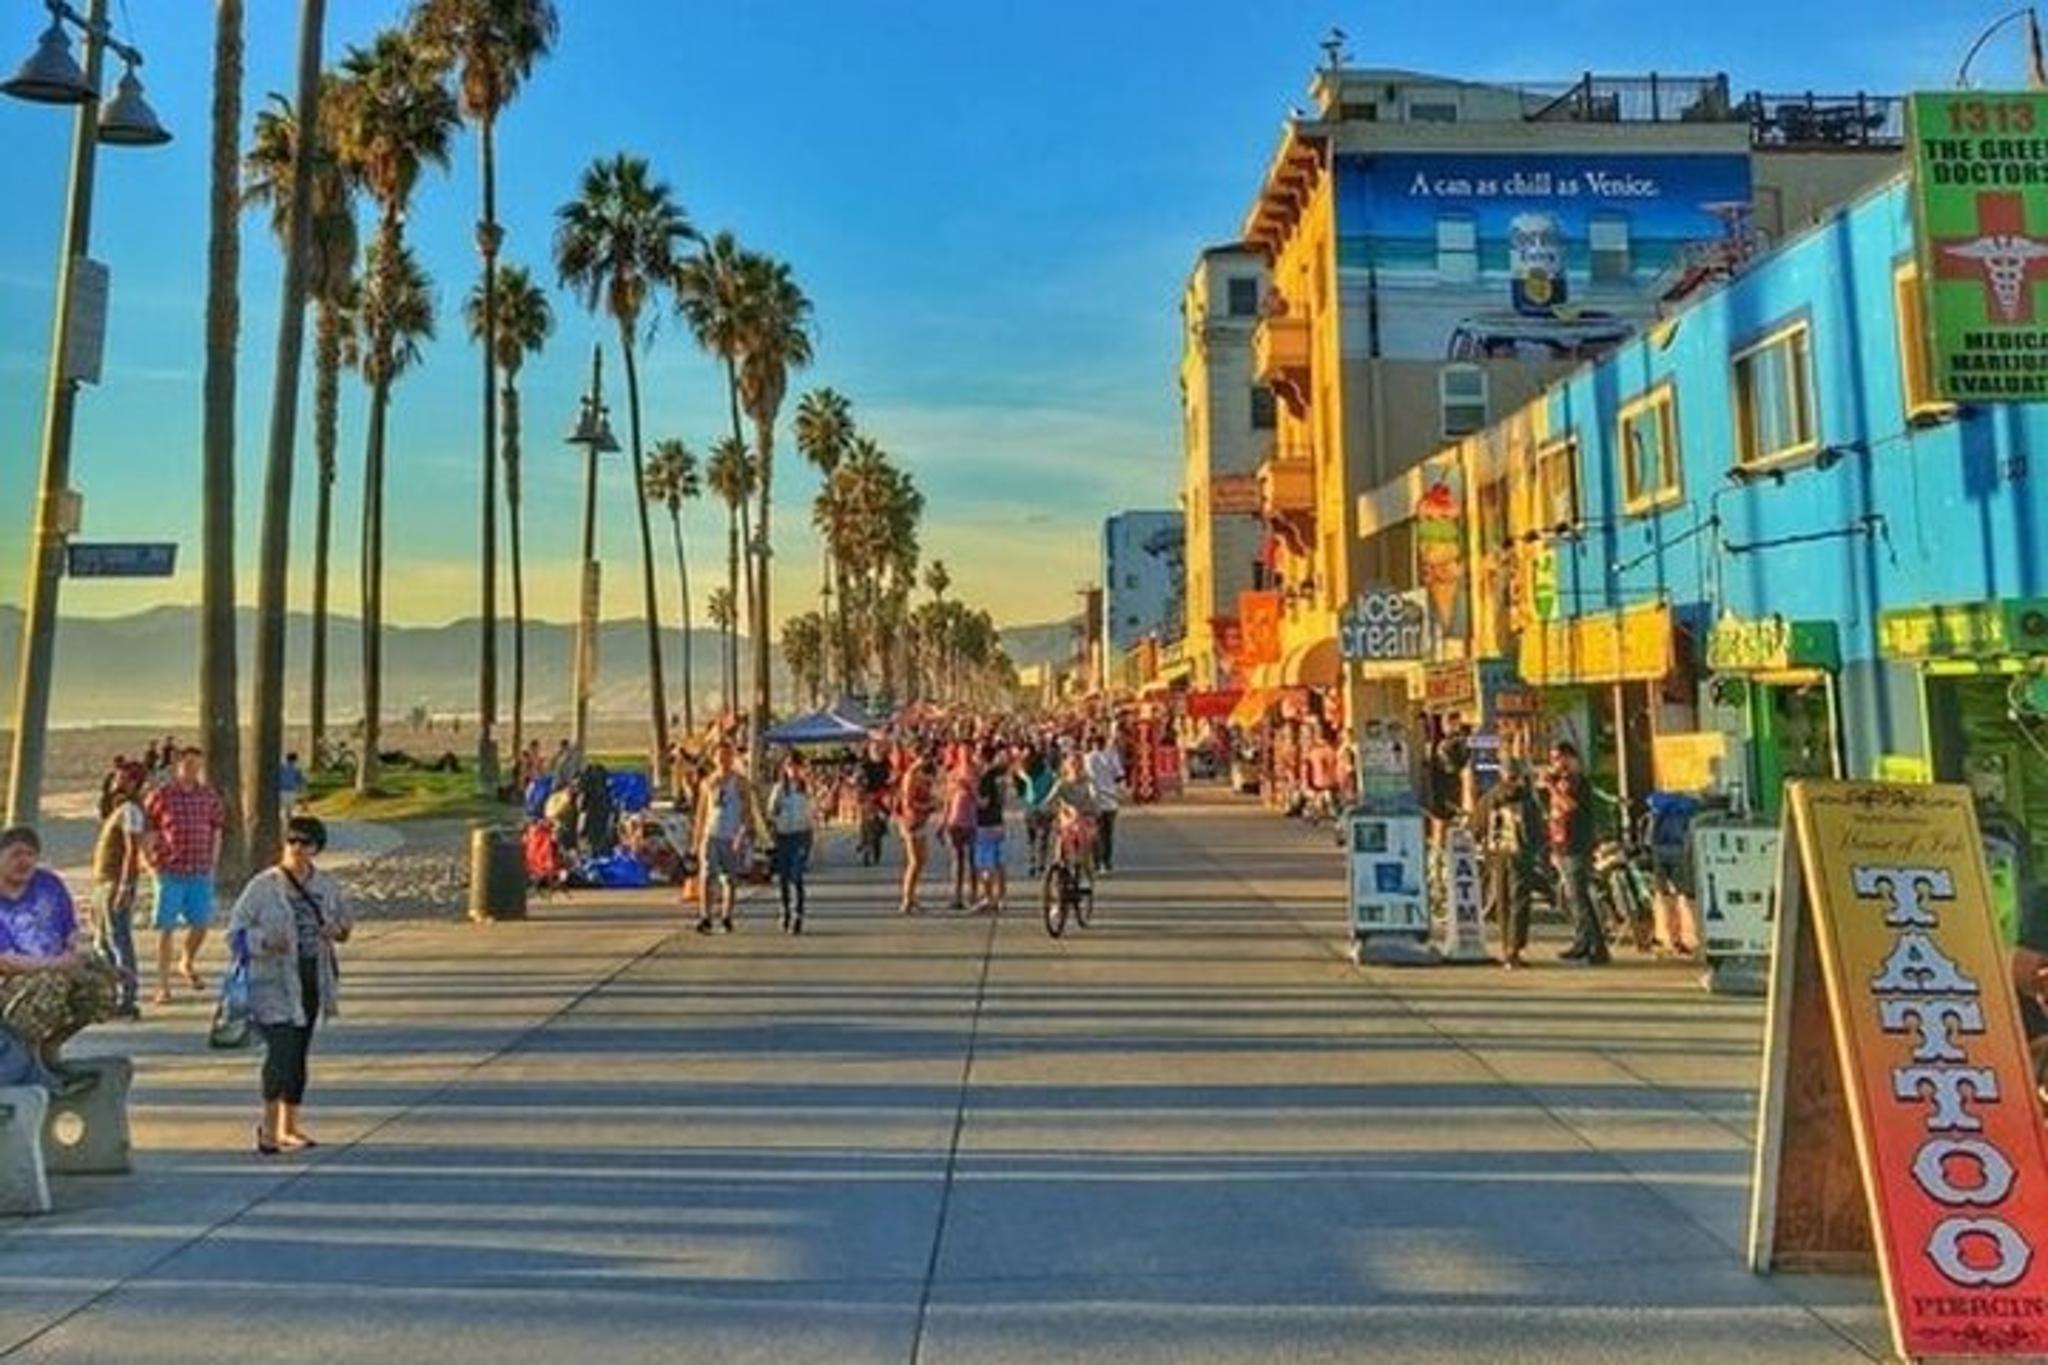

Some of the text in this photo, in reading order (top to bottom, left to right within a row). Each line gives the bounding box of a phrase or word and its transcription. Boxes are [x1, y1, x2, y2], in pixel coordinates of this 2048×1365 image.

[1947, 101, 2035, 134] 1313
[1924, 139, 2048, 161] THE GREE
[1410, 172, 1660, 196] A can as chill as Venice.
[1456, 858, 1478, 923] ATM
[1852, 865, 2034, 1288] TATTOO
[1913, 1296, 2048, 1317] PIERCIN
